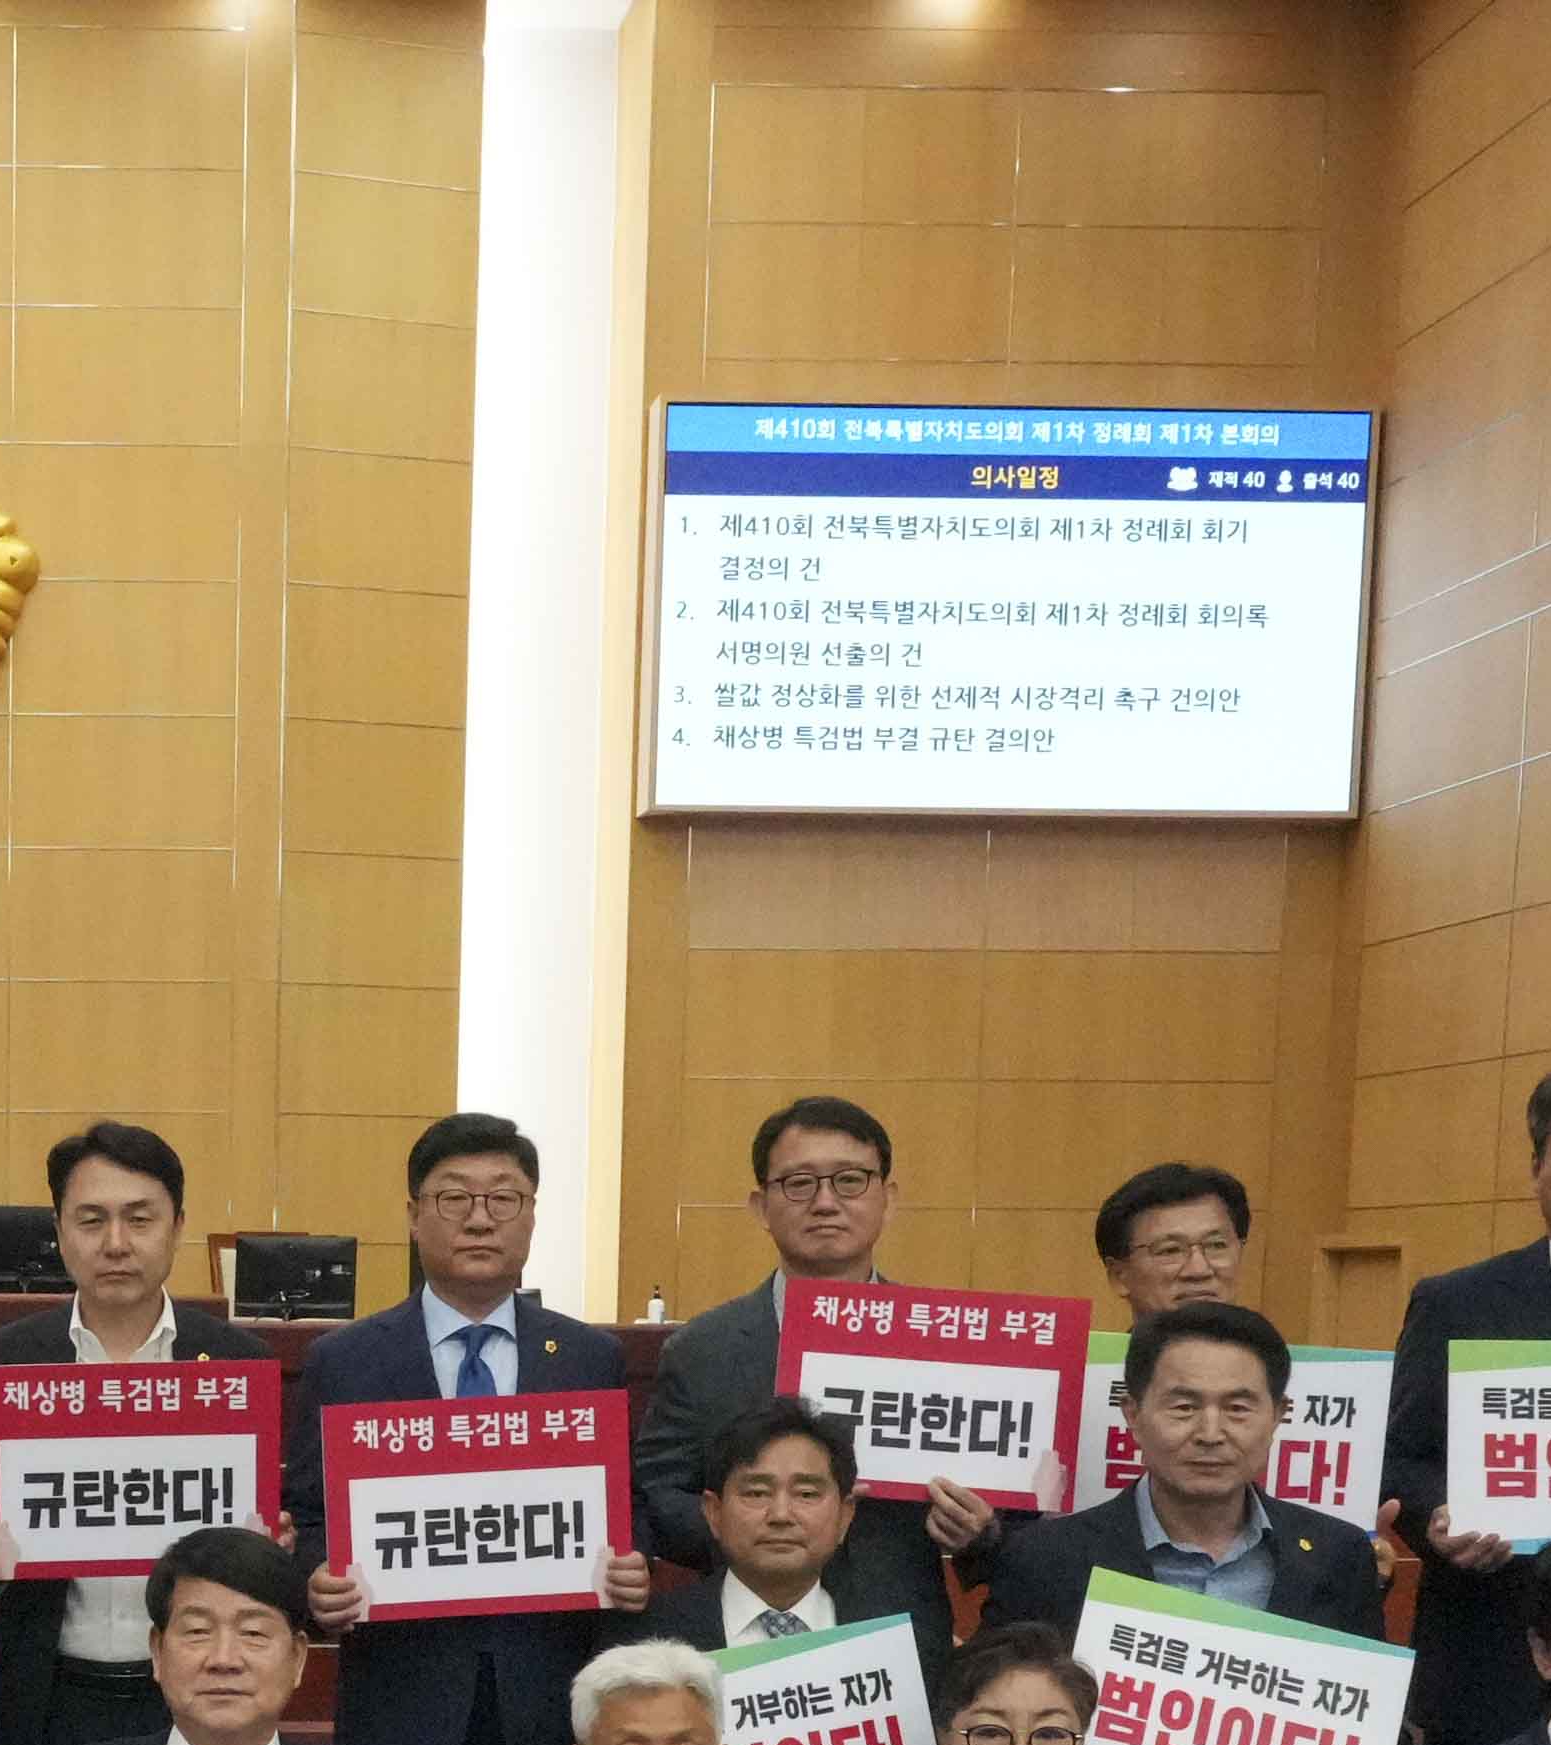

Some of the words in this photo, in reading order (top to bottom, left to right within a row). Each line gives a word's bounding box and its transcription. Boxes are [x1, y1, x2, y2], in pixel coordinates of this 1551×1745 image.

[755, 418, 837, 443] 제410회
[1031, 419, 1087, 444] 제1차
[1093, 420, 1154, 446] 정례회
[1160, 420, 1216, 446] 제1차
[1220, 420, 1280, 447] 본회의
[971, 465, 1060, 489] 의사일정
[1242, 470, 1266, 489] 40
[1336, 471, 1359, 491] 40
[720, 514, 812, 538] 제410회
[825, 515, 1039, 540] 전북특별자치도의회
[1050, 518, 1112, 541] 제1차
[1123, 519, 1191, 542] 정례회
[1202, 520, 1246, 543] 회기
[721, 557, 788, 581] 결정의
[801, 557, 820, 581] 건
[717, 599, 809, 623] 제410회
[822, 600, 1035, 625] 전북특별자치도의회
[1047, 602, 1105, 626] 제1차
[1120, 603, 1186, 627] 정례회
[1199, 604, 1267, 628] 회의록
[717, 642, 809, 665] 서명의원
[822, 643, 889, 666] 선출의
[902, 643, 921, 667] 건
[715, 684, 760, 707] 쌀값
[772, 684, 864, 708] 정상화를
[875, 685, 921, 709] 위한
[932, 686, 999, 709] 선제적
[1011, 687, 1103, 710] 시장격리
[1114, 688, 1160, 711] 촉구
[1172, 688, 1240, 712] 건의안
[714, 726, 782, 749] 채상병
[794, 727, 862, 750] 특검법
[874, 728, 917, 751] 부결
[930, 728, 975, 751] 규탄
[986, 728, 1054, 752] 결의안
[812, 1295, 894, 1335] 채상병
[905, 1303, 989, 1341] 특검법
[1000, 1310, 1056, 1346] 부결
[3, 1379, 85, 1416] 채상병
[97, 1377, 181, 1413] 특검법
[193, 1376, 248, 1410] 부결
[353, 1415, 434, 1453] 채상병
[447, 1410, 529, 1449] 특검법
[541, 1406, 596, 1442] 부결
[22, 1467, 234, 1529] 규탄한다!
[375, 1500, 585, 1570] 규탄한다!
[1109, 1623, 1189, 1675] 특검을
[1195, 1648, 1305, 1706] 거부하는
[1312, 1679, 1370, 1722] 자가
